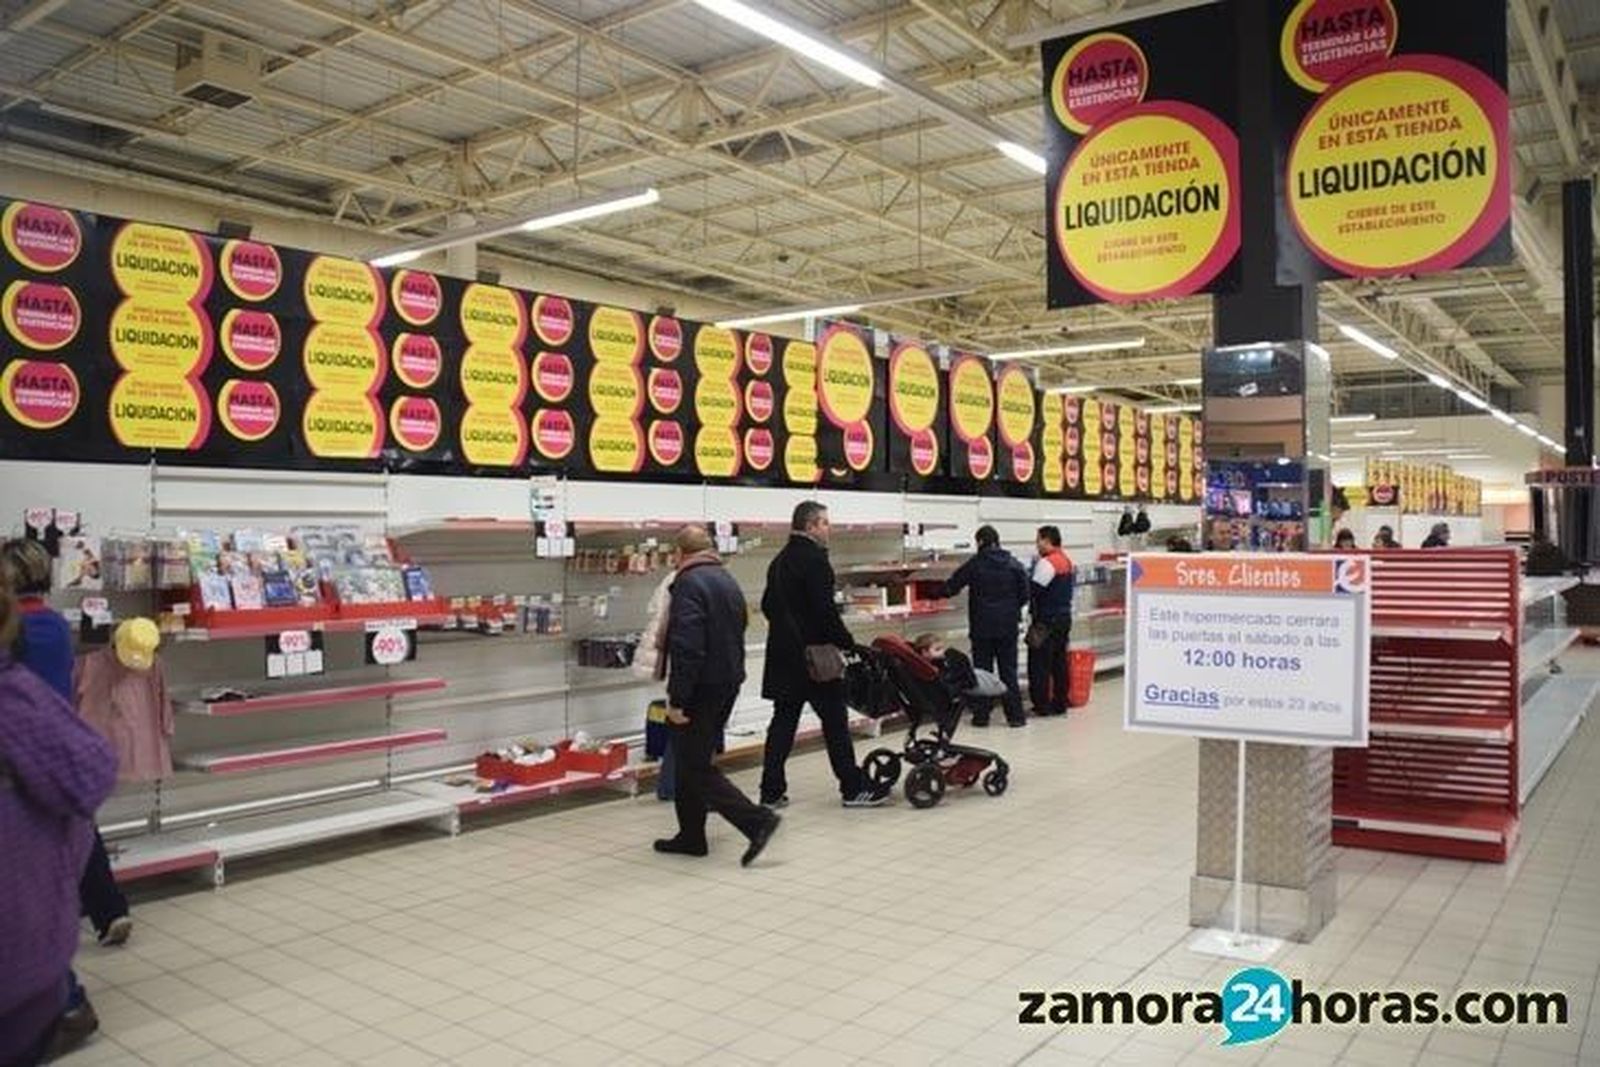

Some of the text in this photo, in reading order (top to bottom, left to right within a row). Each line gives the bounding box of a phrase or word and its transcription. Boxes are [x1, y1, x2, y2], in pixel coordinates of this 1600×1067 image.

[1301, 5, 1385, 41] HASTA
[1302, 26, 1387, 52] TERMINAR LAS
[1302, 39, 1387, 66] EXISTENCIAS
[1068, 57, 1138, 86] HASTA
[1069, 87, 1140, 109] EXISTENCIAS
[1318, 115, 1463, 150] EN ESTA TIENDA
[1082, 156, 1201, 187] EN ESTA TIENDA
[1298, 140, 1487, 199] LIQUIDACIÓN
[1064, 179, 1220, 230] LIQUIDACIÓN
[1390, 203, 1407, 215] DE
[1410, 200, 1436, 212] ESTE
[1338, 213, 1446, 234] ESTABLECIMIENTO
[1175, 561, 1301, 588] Sres. Clientes
[1150, 607, 1181, 622] Este
[1183, 609, 1281, 626] hipermercado
[1148, 626, 1168, 640] las
[1172, 629, 1224, 643] puertas
[1228, 629, 1242, 643] el
[1303, 635, 1314, 647] a
[1318, 632, 1342, 648] las
[1184, 648, 1302, 672] 12:00 horas
[1144, 683, 1220, 706] Gracias
[1223, 695, 1245, 710] por
[1249, 696, 1285, 710] estos
